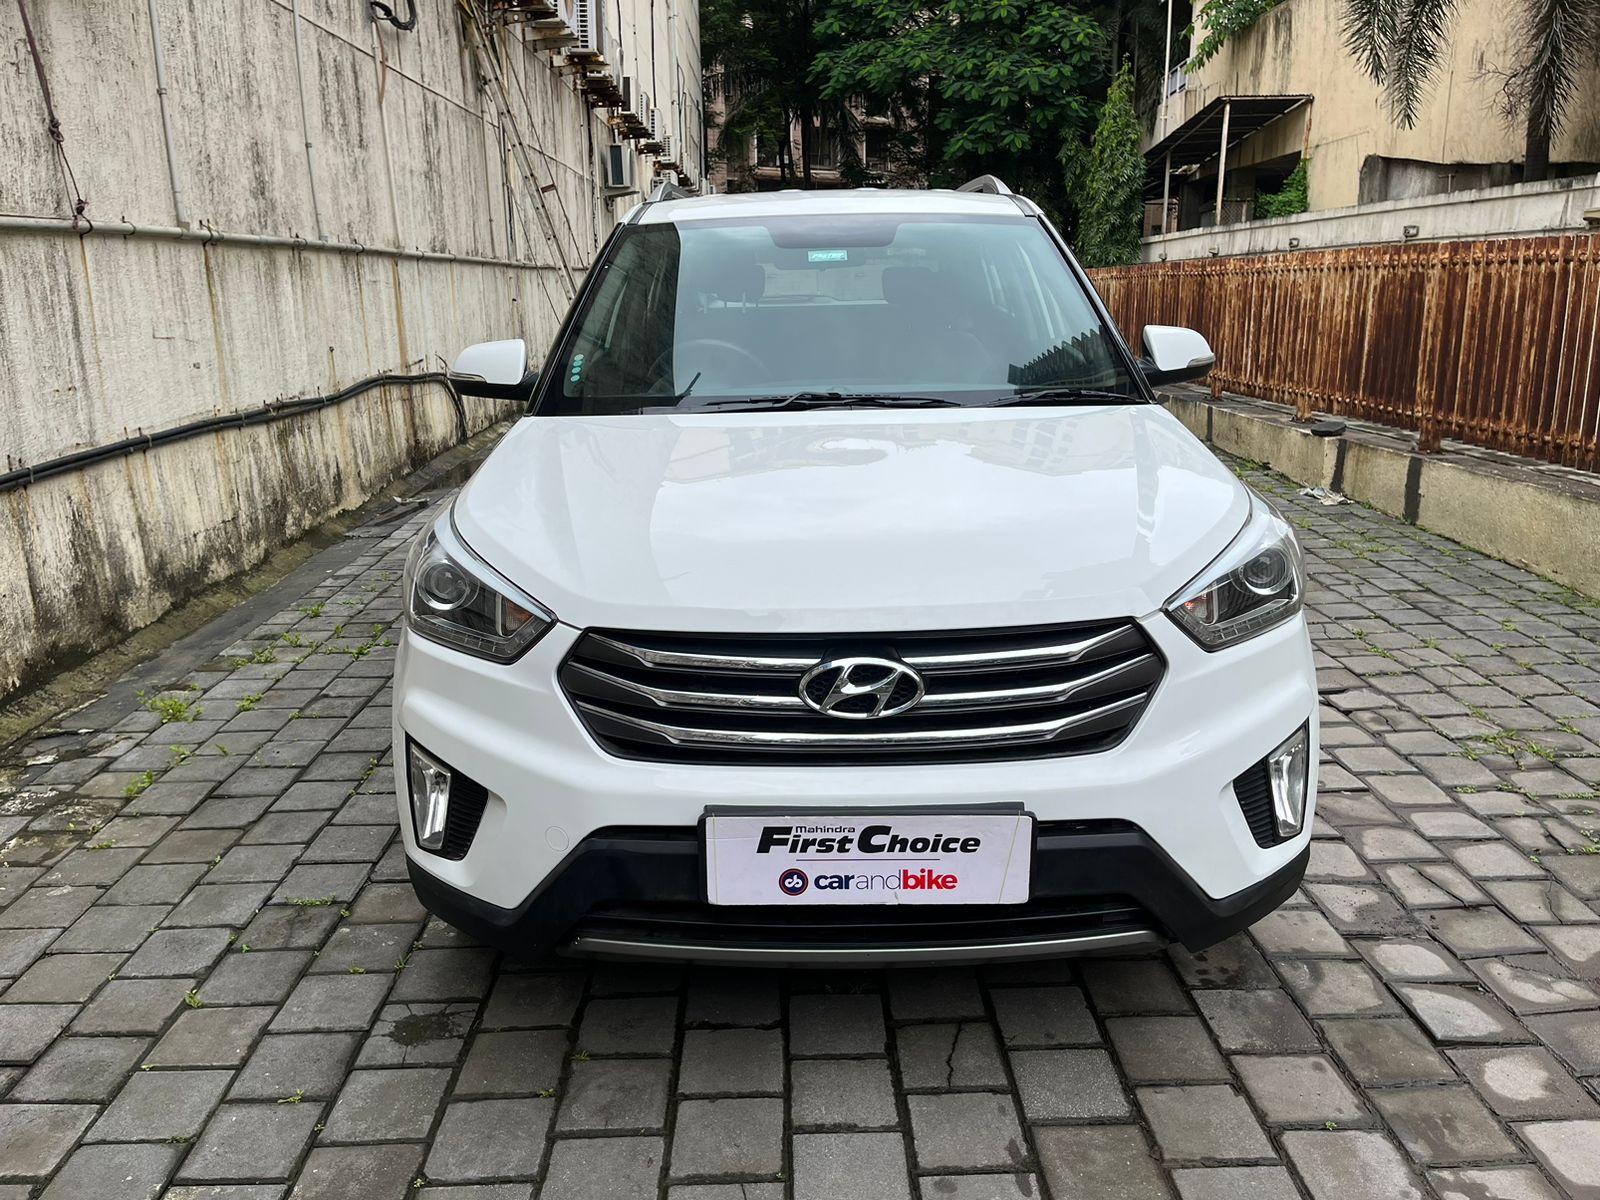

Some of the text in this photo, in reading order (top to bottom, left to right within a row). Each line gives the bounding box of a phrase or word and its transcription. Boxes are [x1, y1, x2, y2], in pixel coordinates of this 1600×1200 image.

[756, 825, 981, 854] First Choice
[795, 825, 856, 833] Mahindra
[813, 868, 958, 890] carandbike
